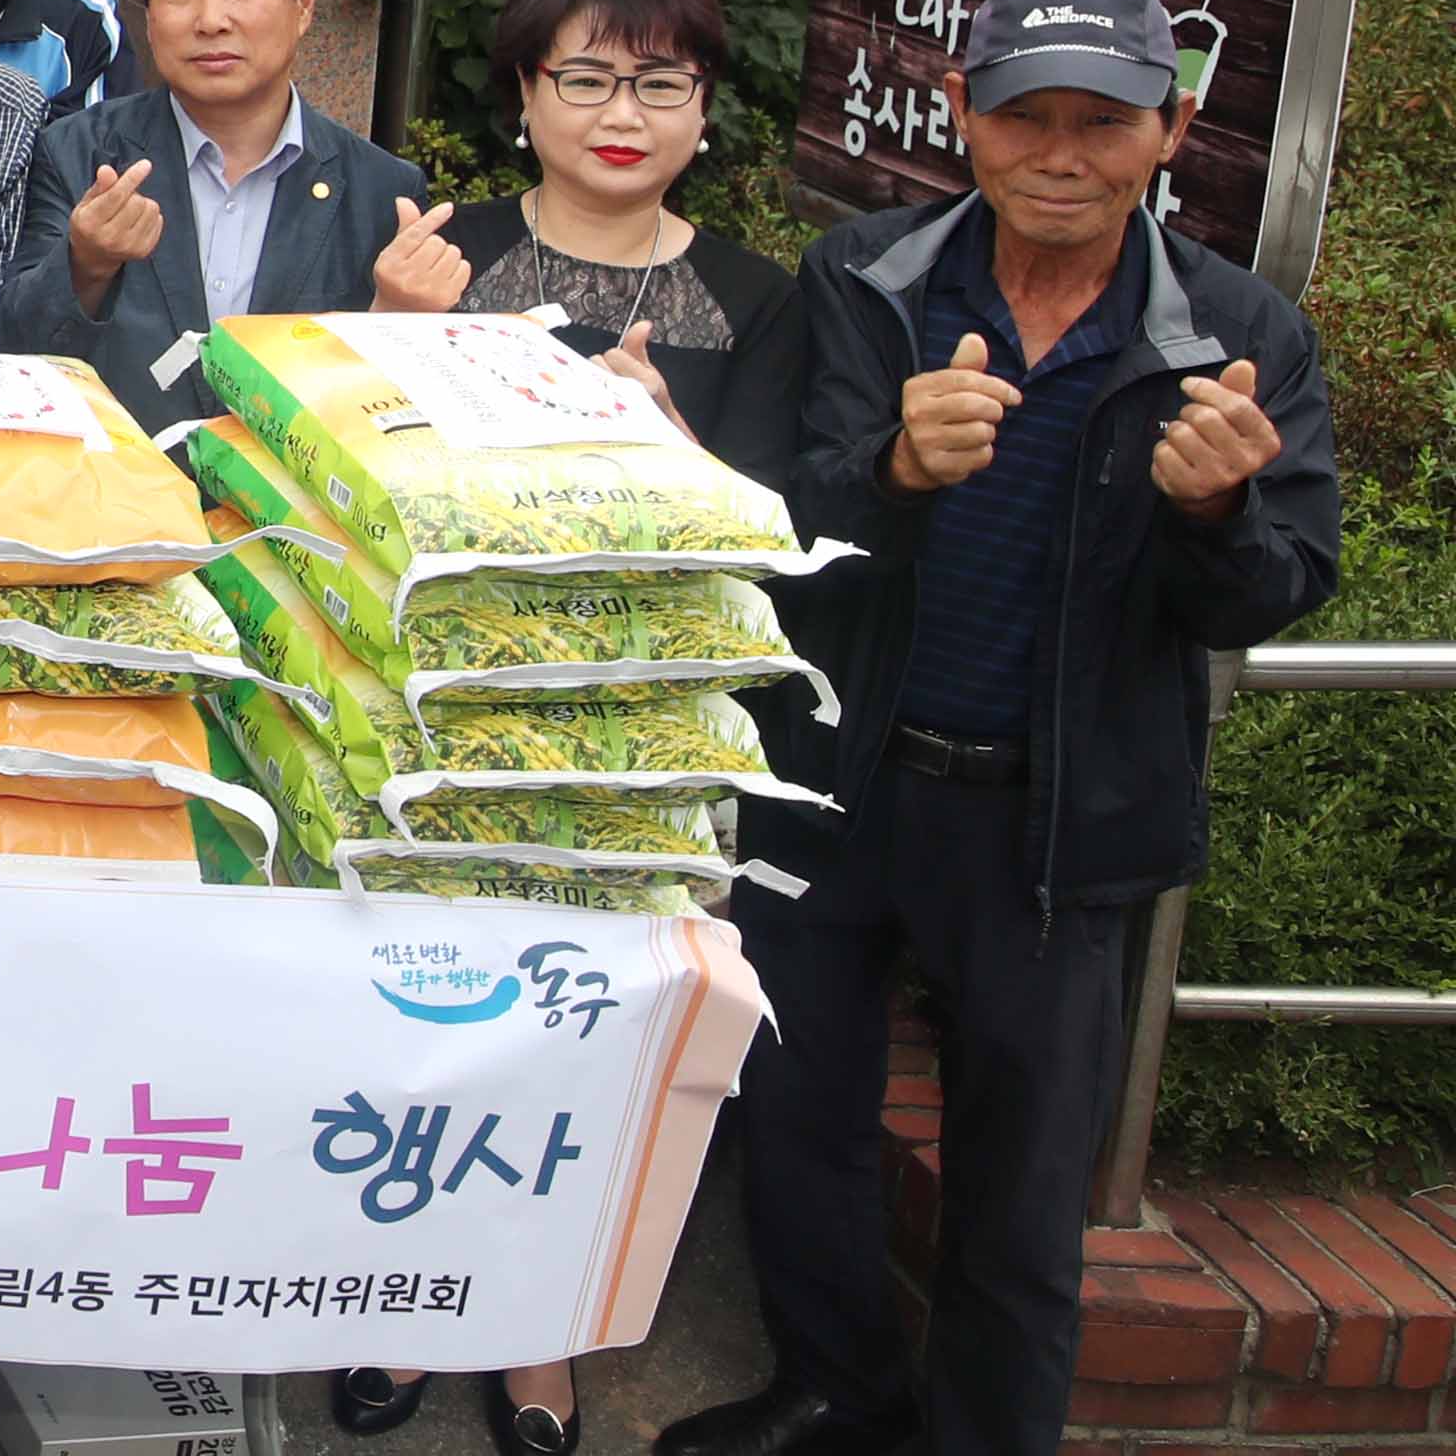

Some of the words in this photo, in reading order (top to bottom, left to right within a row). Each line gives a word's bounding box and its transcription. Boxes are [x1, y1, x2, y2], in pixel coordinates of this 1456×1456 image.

[1045, 4, 1074, 17] THE
[1050, 13, 1115, 30] REDFACE
[510, 486, 673, 514] 사석정미소
[351, 499, 388, 543] 10kg
[510, 594, 666, 621] 사석정미소
[371, 943, 419, 966] 새로운
[420, 942, 462, 967] 변화
[400, 969, 443, 995] 모두가
[445, 967, 493, 996] 행복한
[516, 940, 621, 1041] 동구
[310, 1090, 582, 1225] 행사
[133, 1272, 475, 1320] 주민자치위원회
[143, 1370, 198, 1417] 2016
